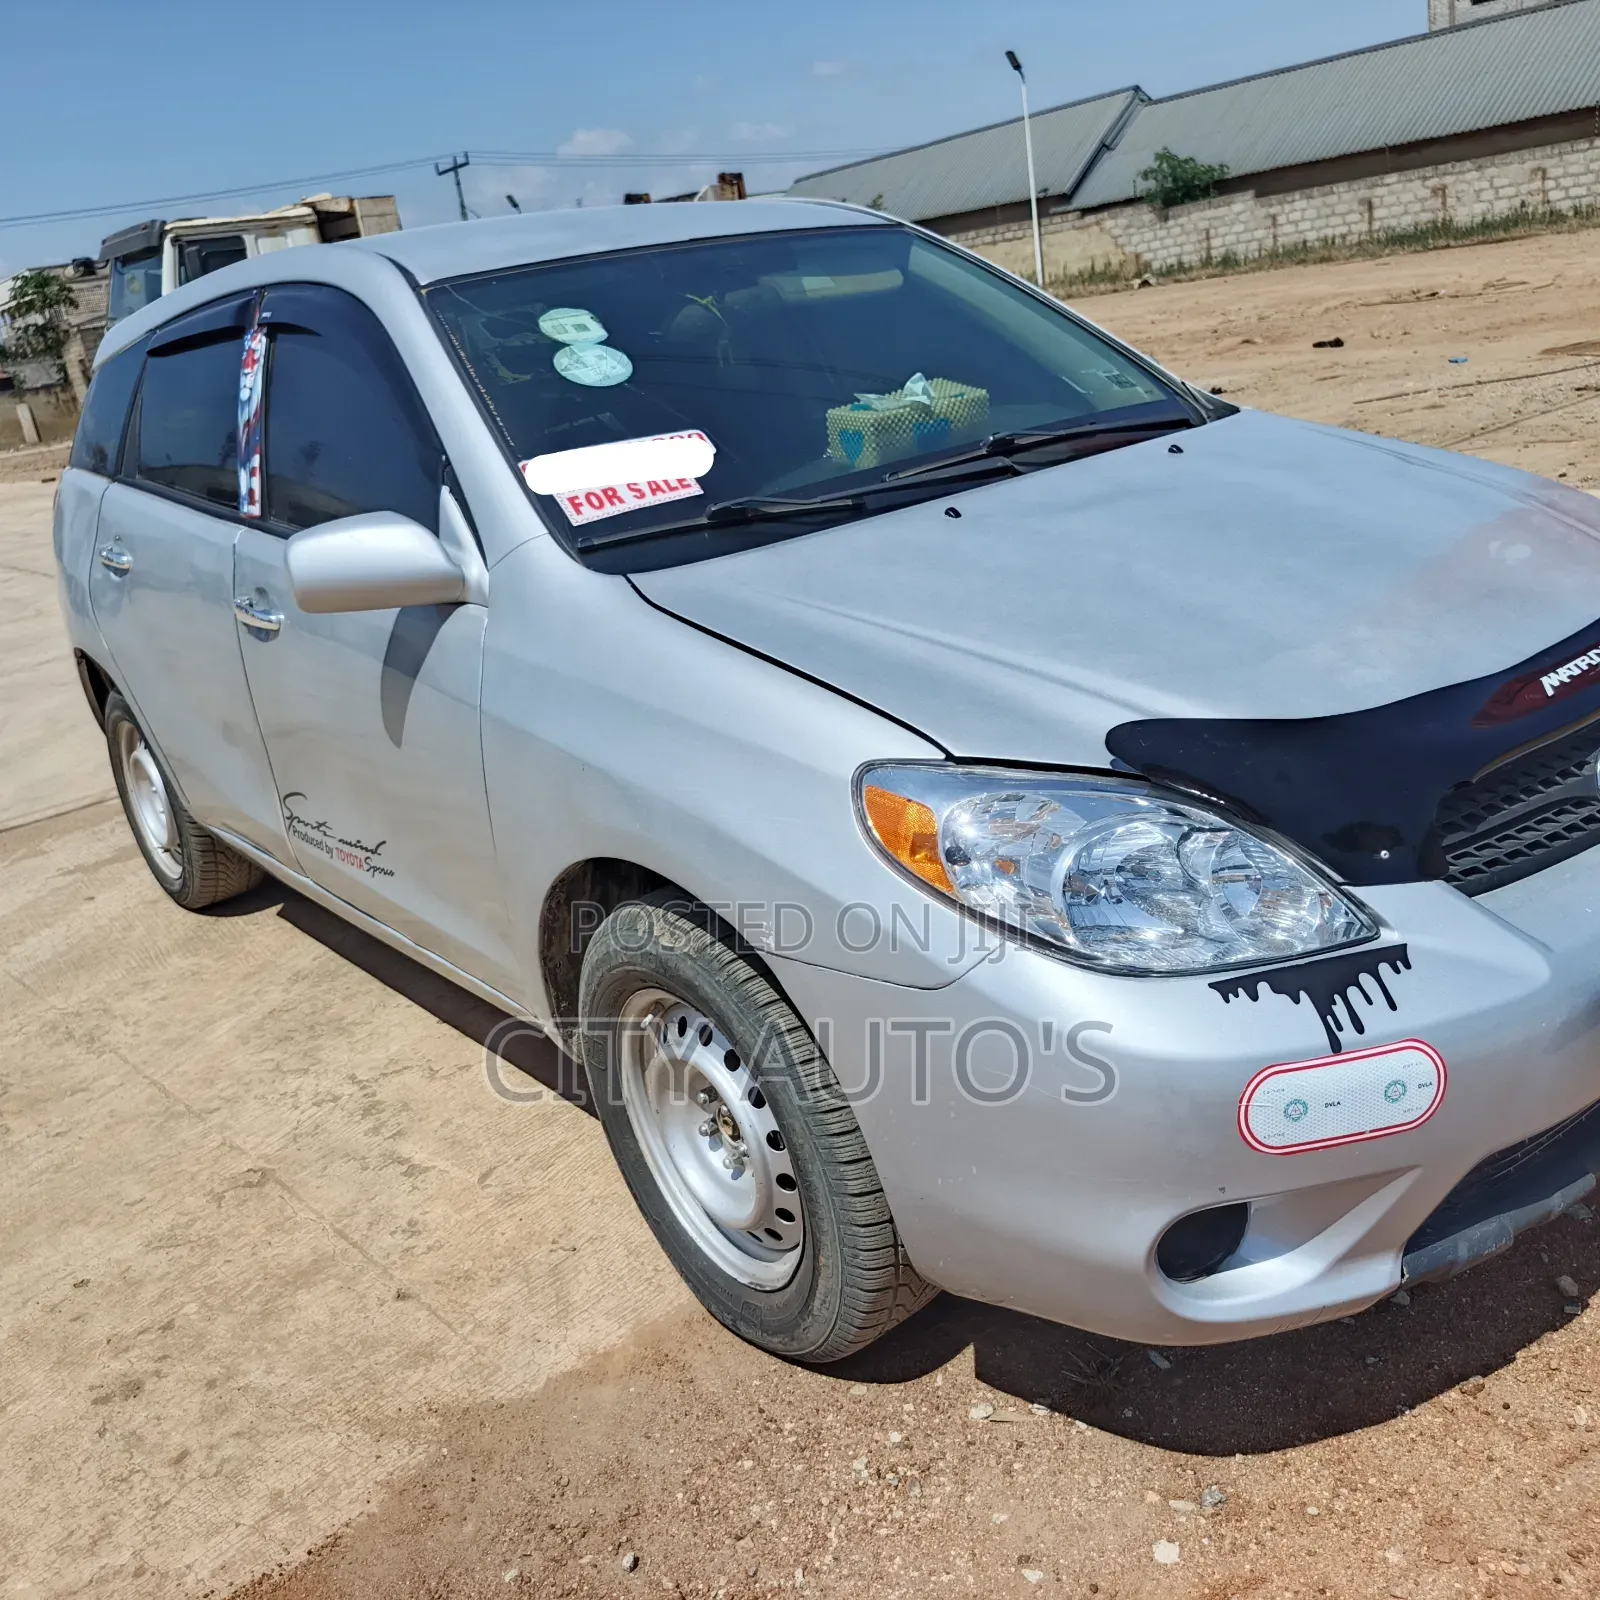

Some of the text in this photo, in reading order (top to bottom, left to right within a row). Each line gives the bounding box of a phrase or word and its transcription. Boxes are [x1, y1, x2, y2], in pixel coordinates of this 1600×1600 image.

[567, 478, 692, 516] FOR SALE
[292, 825, 324, 851] Produced
[324, 841, 334, 859] by
[335, 847, 365, 872] TOYOTA
[1417, 1081, 1433, 1089] DVLA
[1324, 1100, 1342, 1109] DVLA
